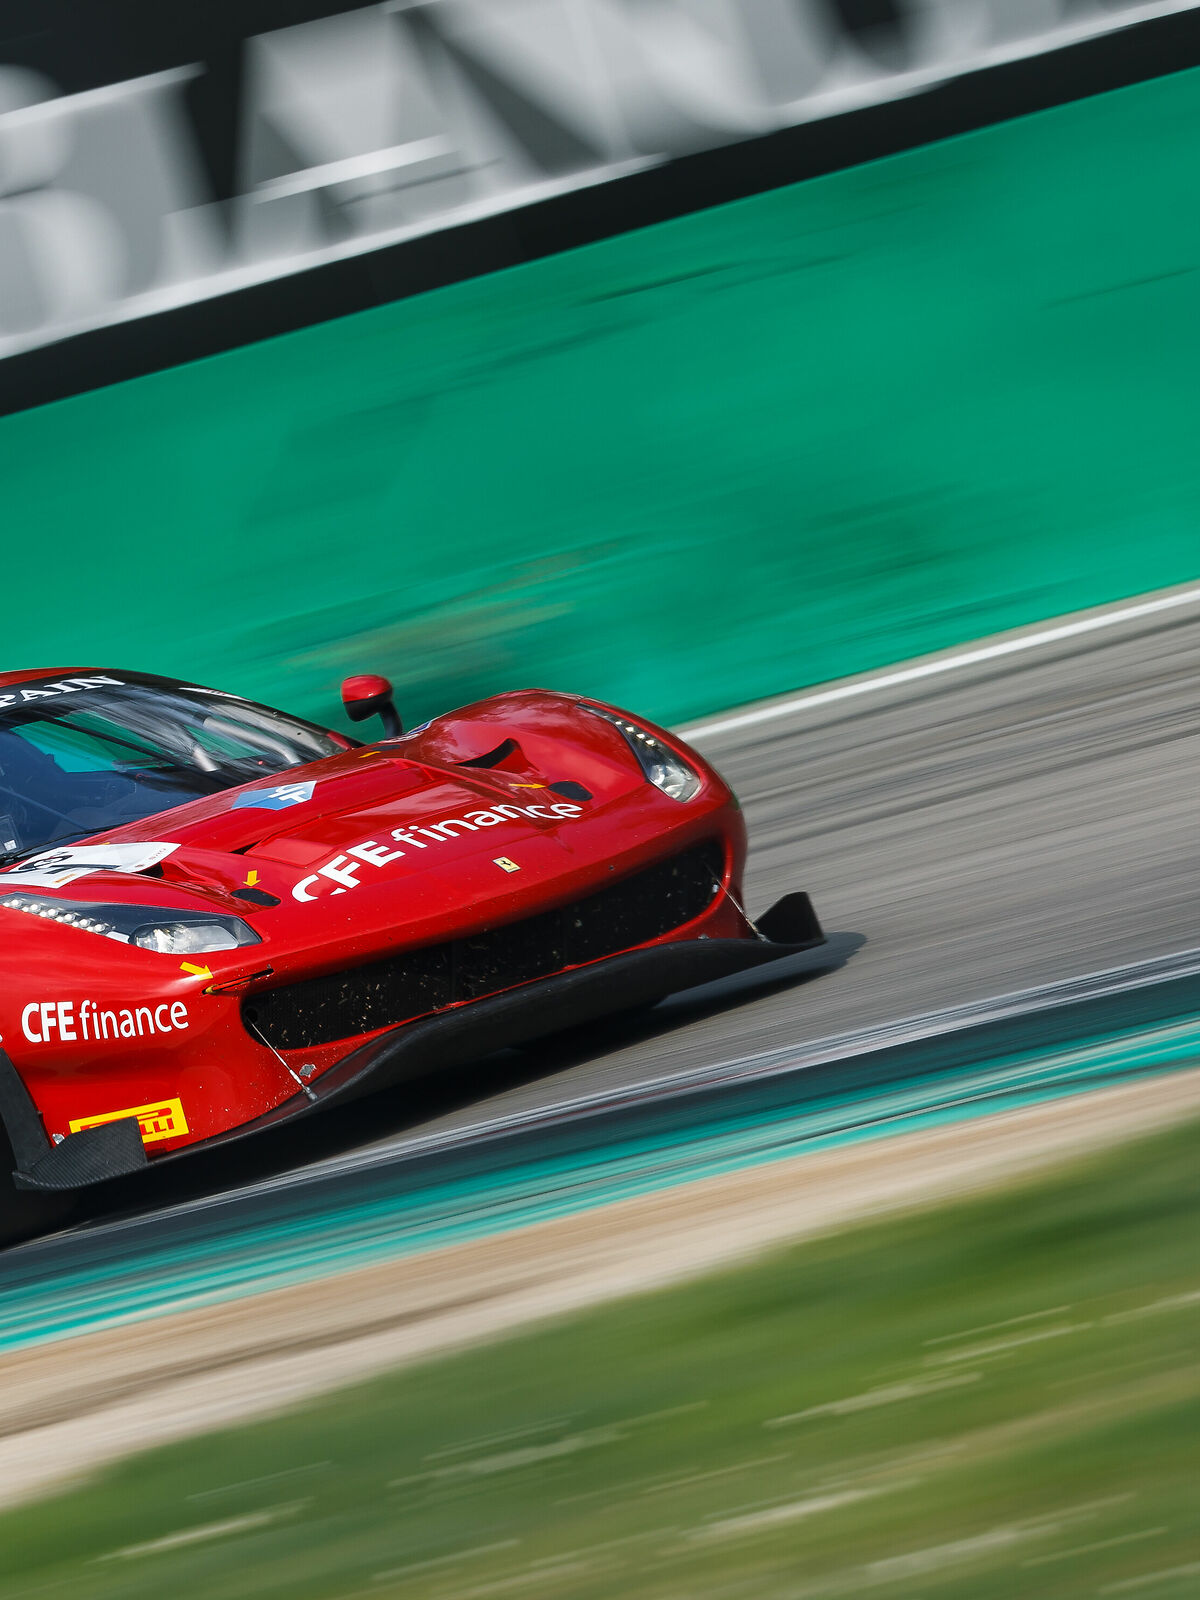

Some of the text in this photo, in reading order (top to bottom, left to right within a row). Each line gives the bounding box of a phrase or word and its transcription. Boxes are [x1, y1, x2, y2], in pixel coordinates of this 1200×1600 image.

[291, 802, 583, 903] CFE finance
[21, 999, 190, 1043] CFE finance
